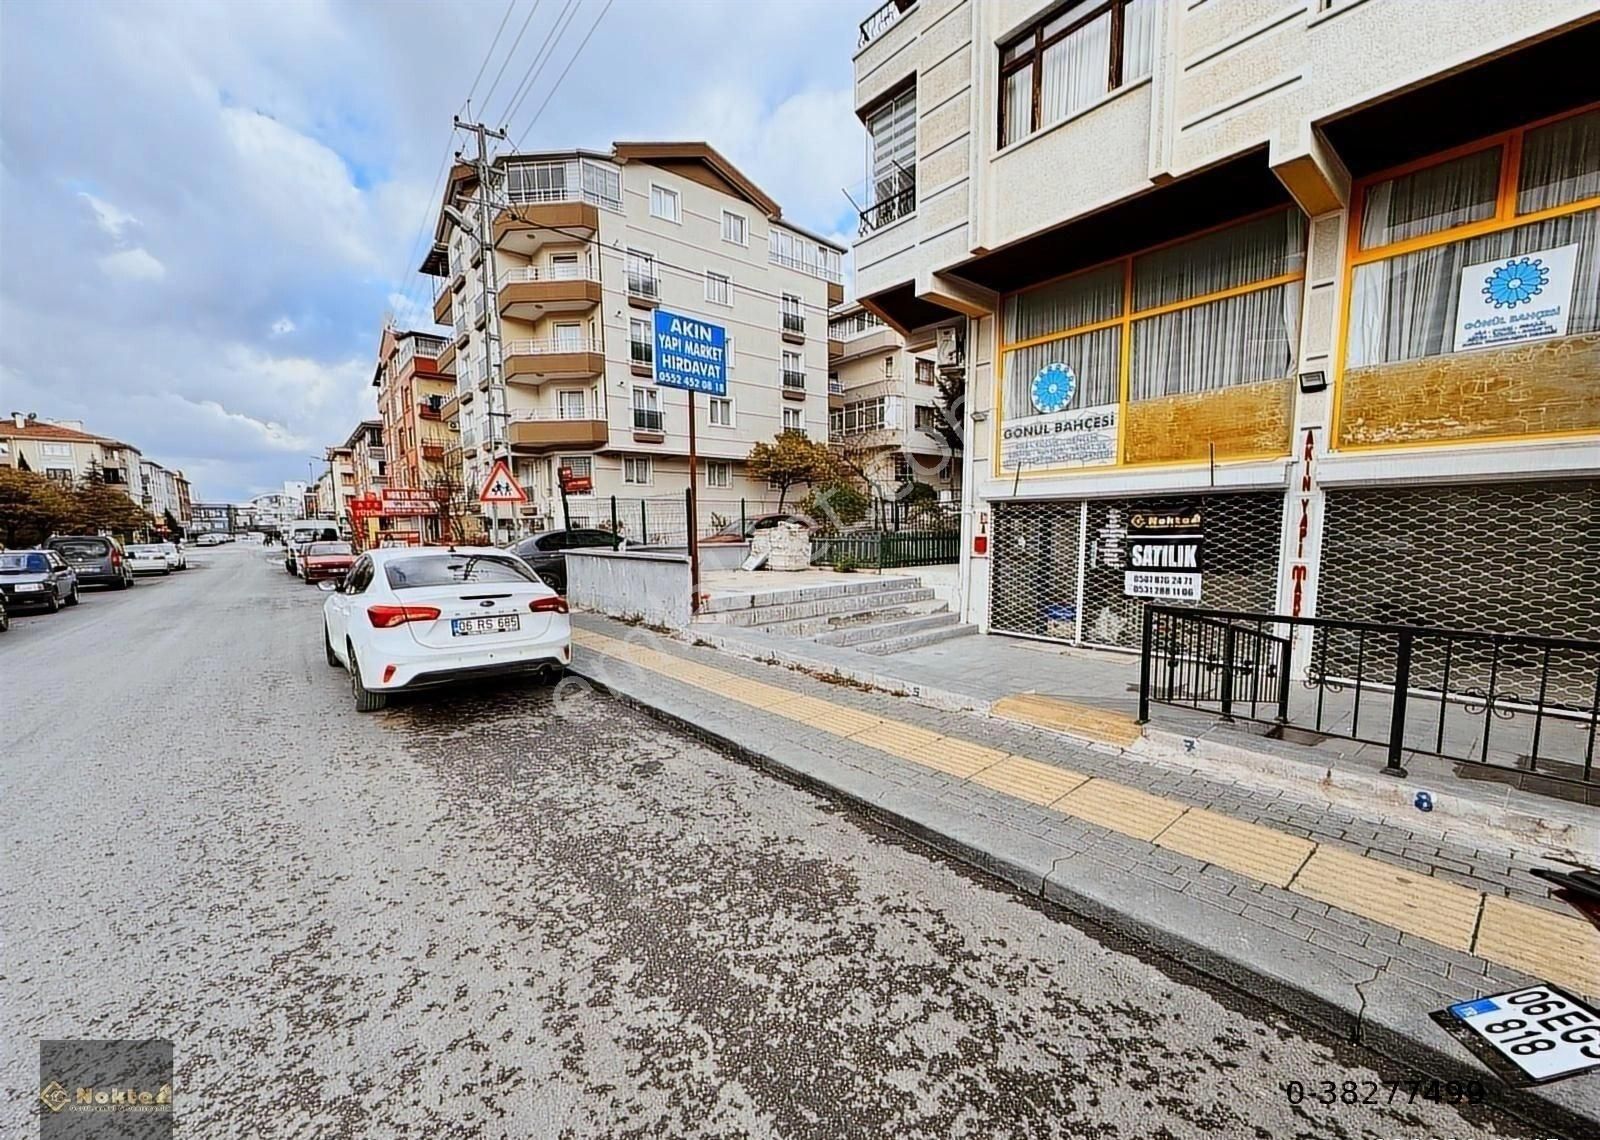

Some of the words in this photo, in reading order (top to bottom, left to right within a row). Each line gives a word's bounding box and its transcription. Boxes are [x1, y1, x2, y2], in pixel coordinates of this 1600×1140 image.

[670, 319, 712, 341] AKIN
[658, 333, 682, 353] YAPI
[684, 340, 723, 361] MARKET
[662, 353, 721, 379] HIRDAVAT
[659, 371, 682, 385] 0552
[683, 376, 700, 388] 452
[1054, 411, 1115, 433] BAHÇESİ
[1303, 429, 1314, 492] AKIN
[1132, 544, 1197, 568] SATILIK
[459, 621, 472, 631] 06
[477, 619, 493, 629] RS
[497, 616, 517, 628] 685
[1414, 791, 1433, 812] 8
[1484, 1018, 1557, 1056] 818
